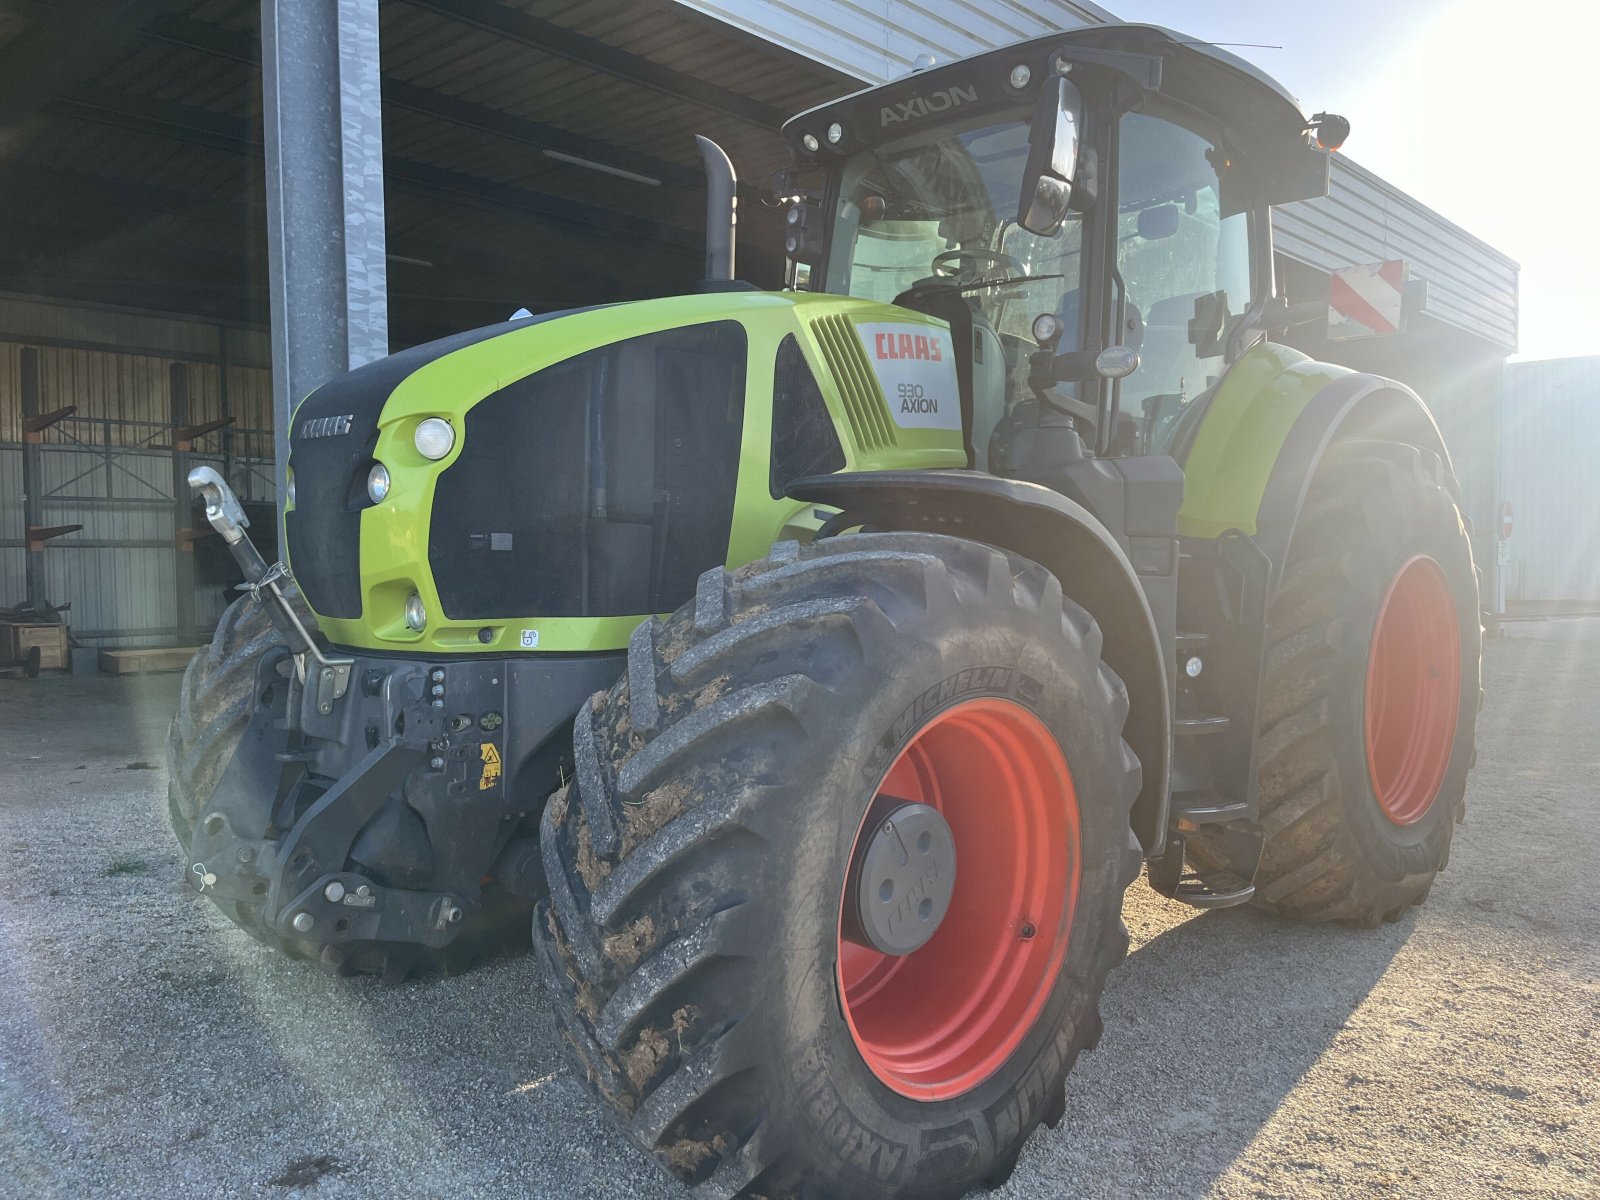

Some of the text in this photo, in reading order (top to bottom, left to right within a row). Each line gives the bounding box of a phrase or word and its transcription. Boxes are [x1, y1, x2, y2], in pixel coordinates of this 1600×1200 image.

[880, 84, 978, 128] AXION
[875, 333, 942, 361] CLAAS
[898, 384, 923, 398] 930
[901, 399, 938, 414] AXION
[892, 667, 1015, 745] MICHELIN
